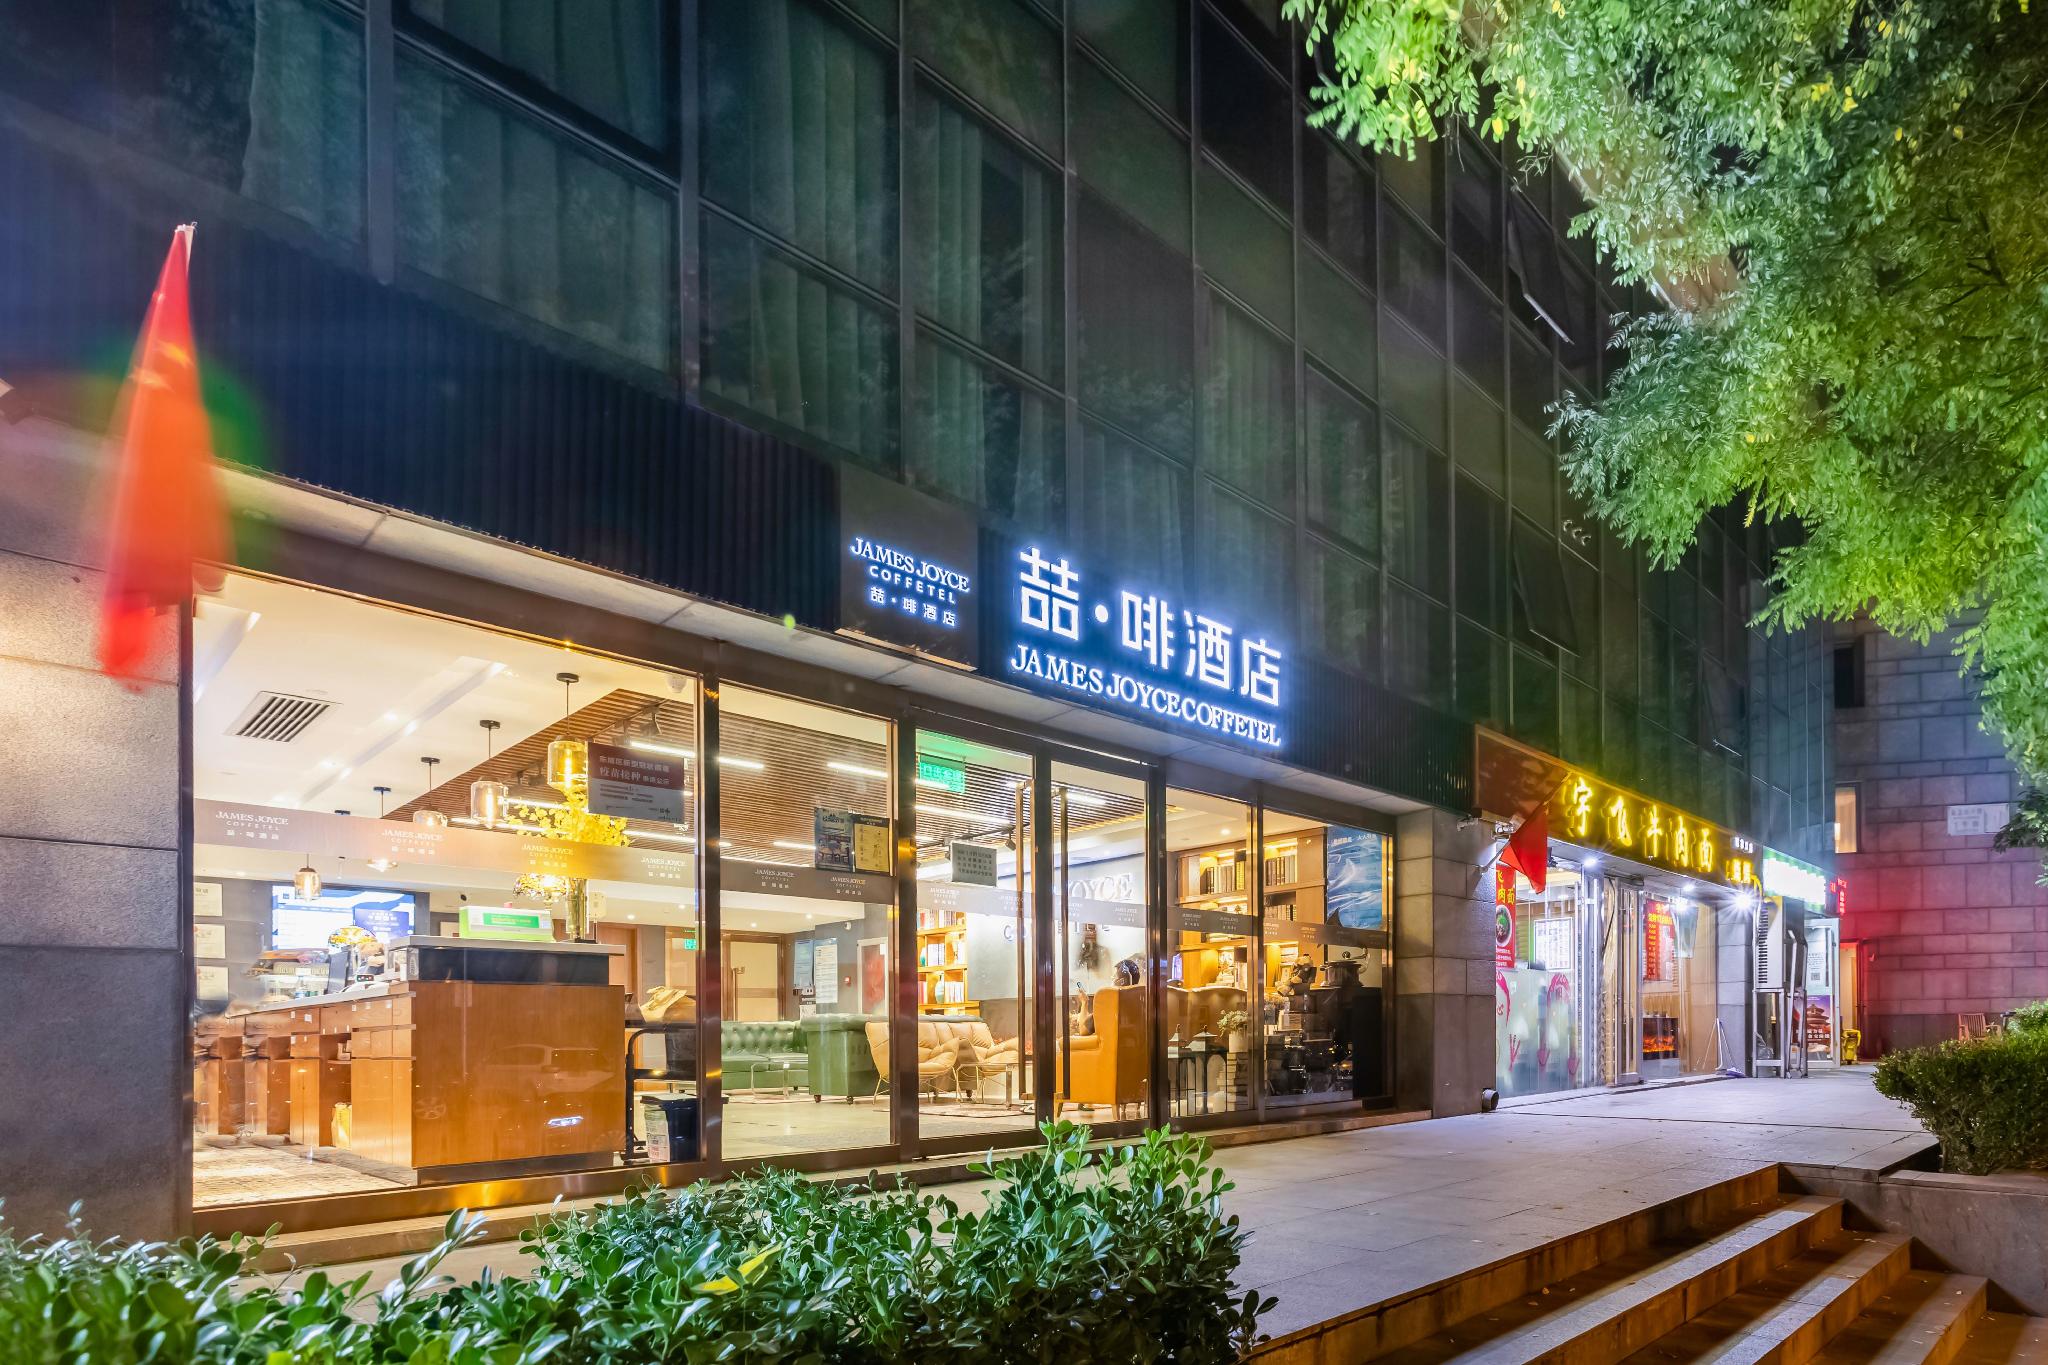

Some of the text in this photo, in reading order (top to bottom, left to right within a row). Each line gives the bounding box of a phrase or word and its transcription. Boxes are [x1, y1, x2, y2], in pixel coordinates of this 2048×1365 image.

[850, 537, 970, 592] JAMES JOYCE
[869, 565, 956, 604] COFFETEL
[1010, 644, 1104, 694] JAMES
[215, 811, 254, 822] JAMES
[1069, 872, 1134, 902] OYCE
